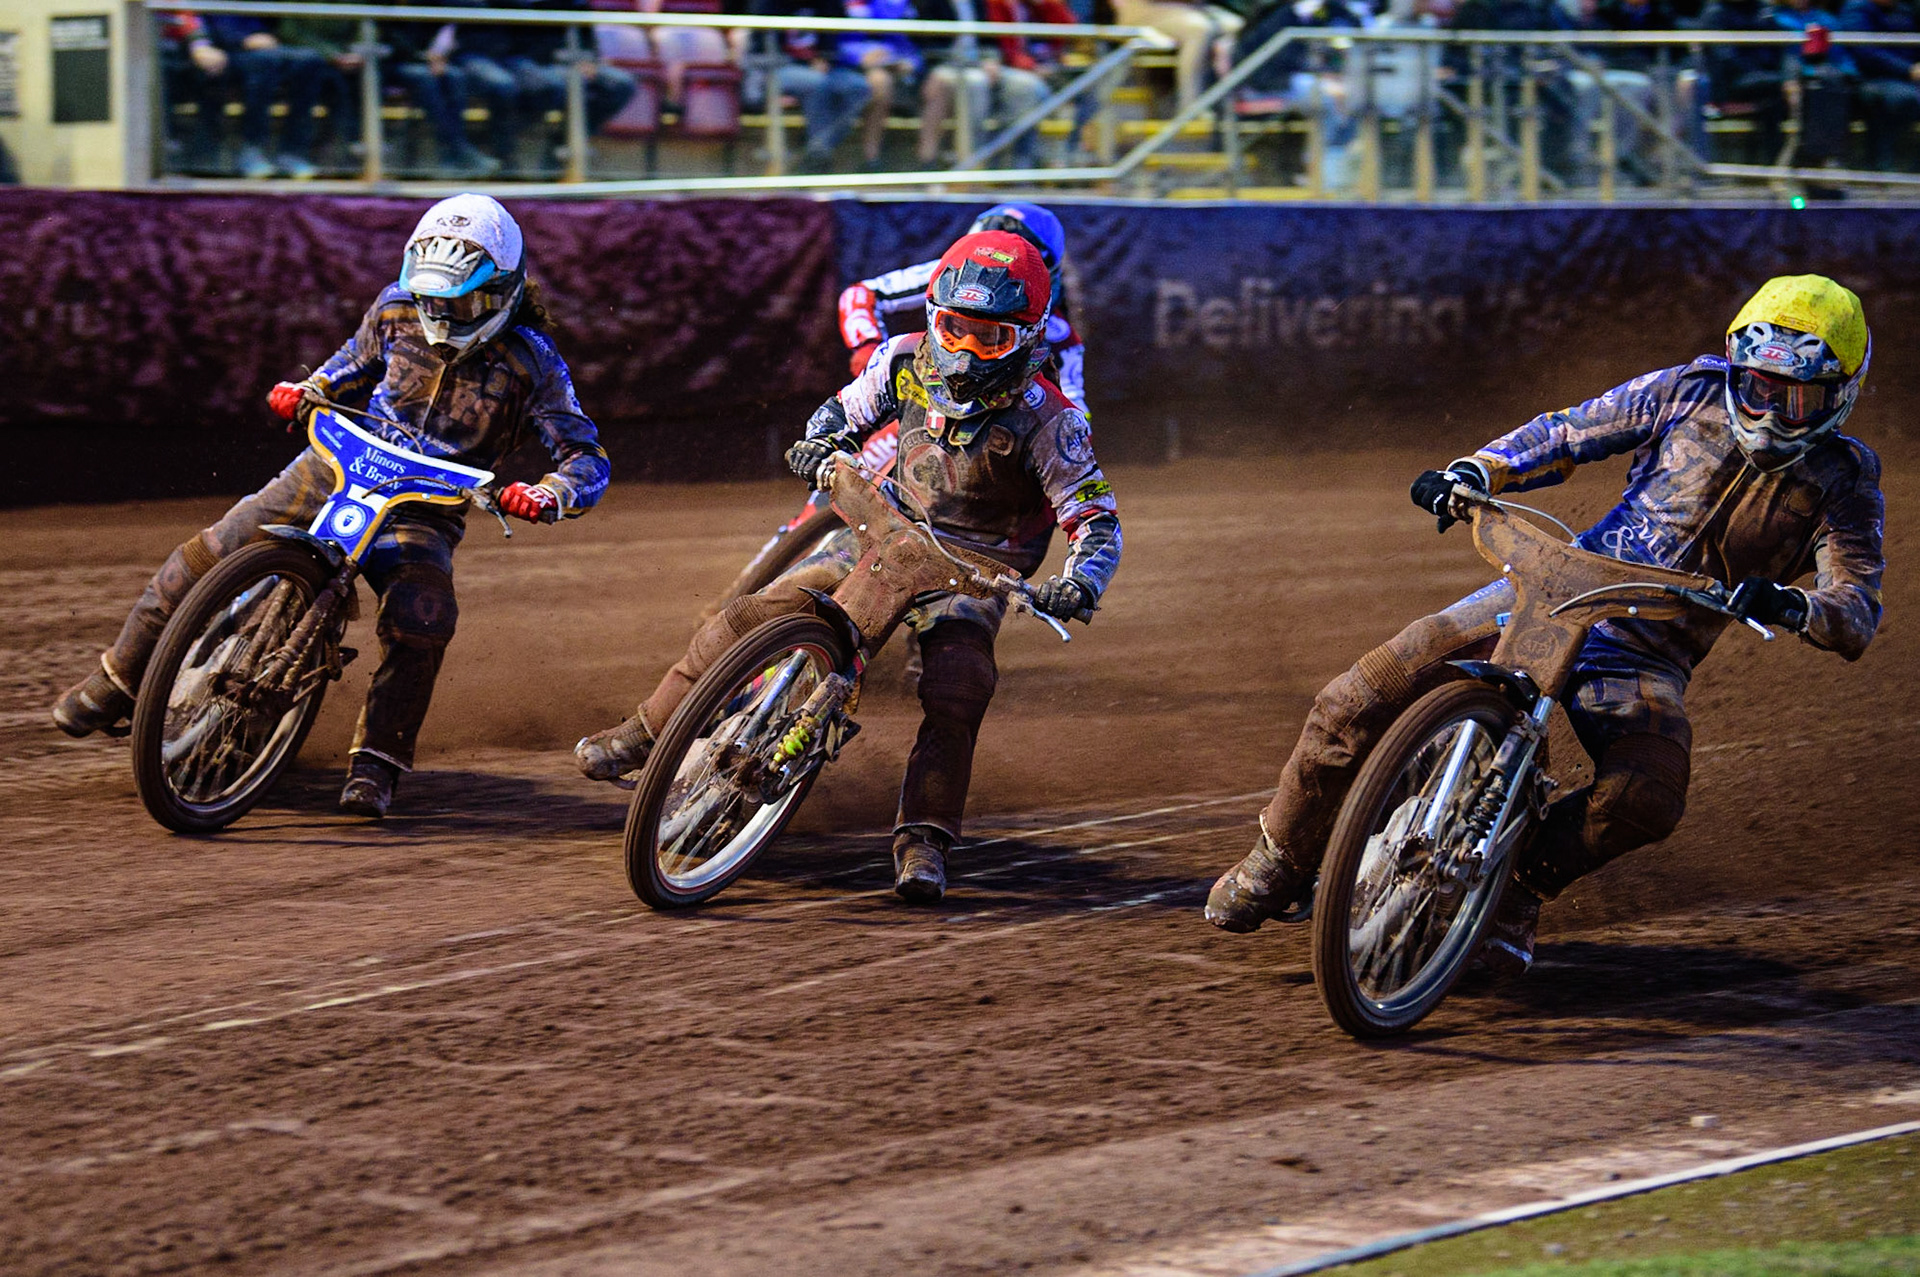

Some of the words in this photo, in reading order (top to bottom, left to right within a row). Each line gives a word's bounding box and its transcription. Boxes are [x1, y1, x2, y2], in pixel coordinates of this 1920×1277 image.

[955, 289, 988, 301] STS
[1760, 348, 1790, 361] STS
[348, 456, 367, 476] &
[362, 447, 407, 475] Minors
